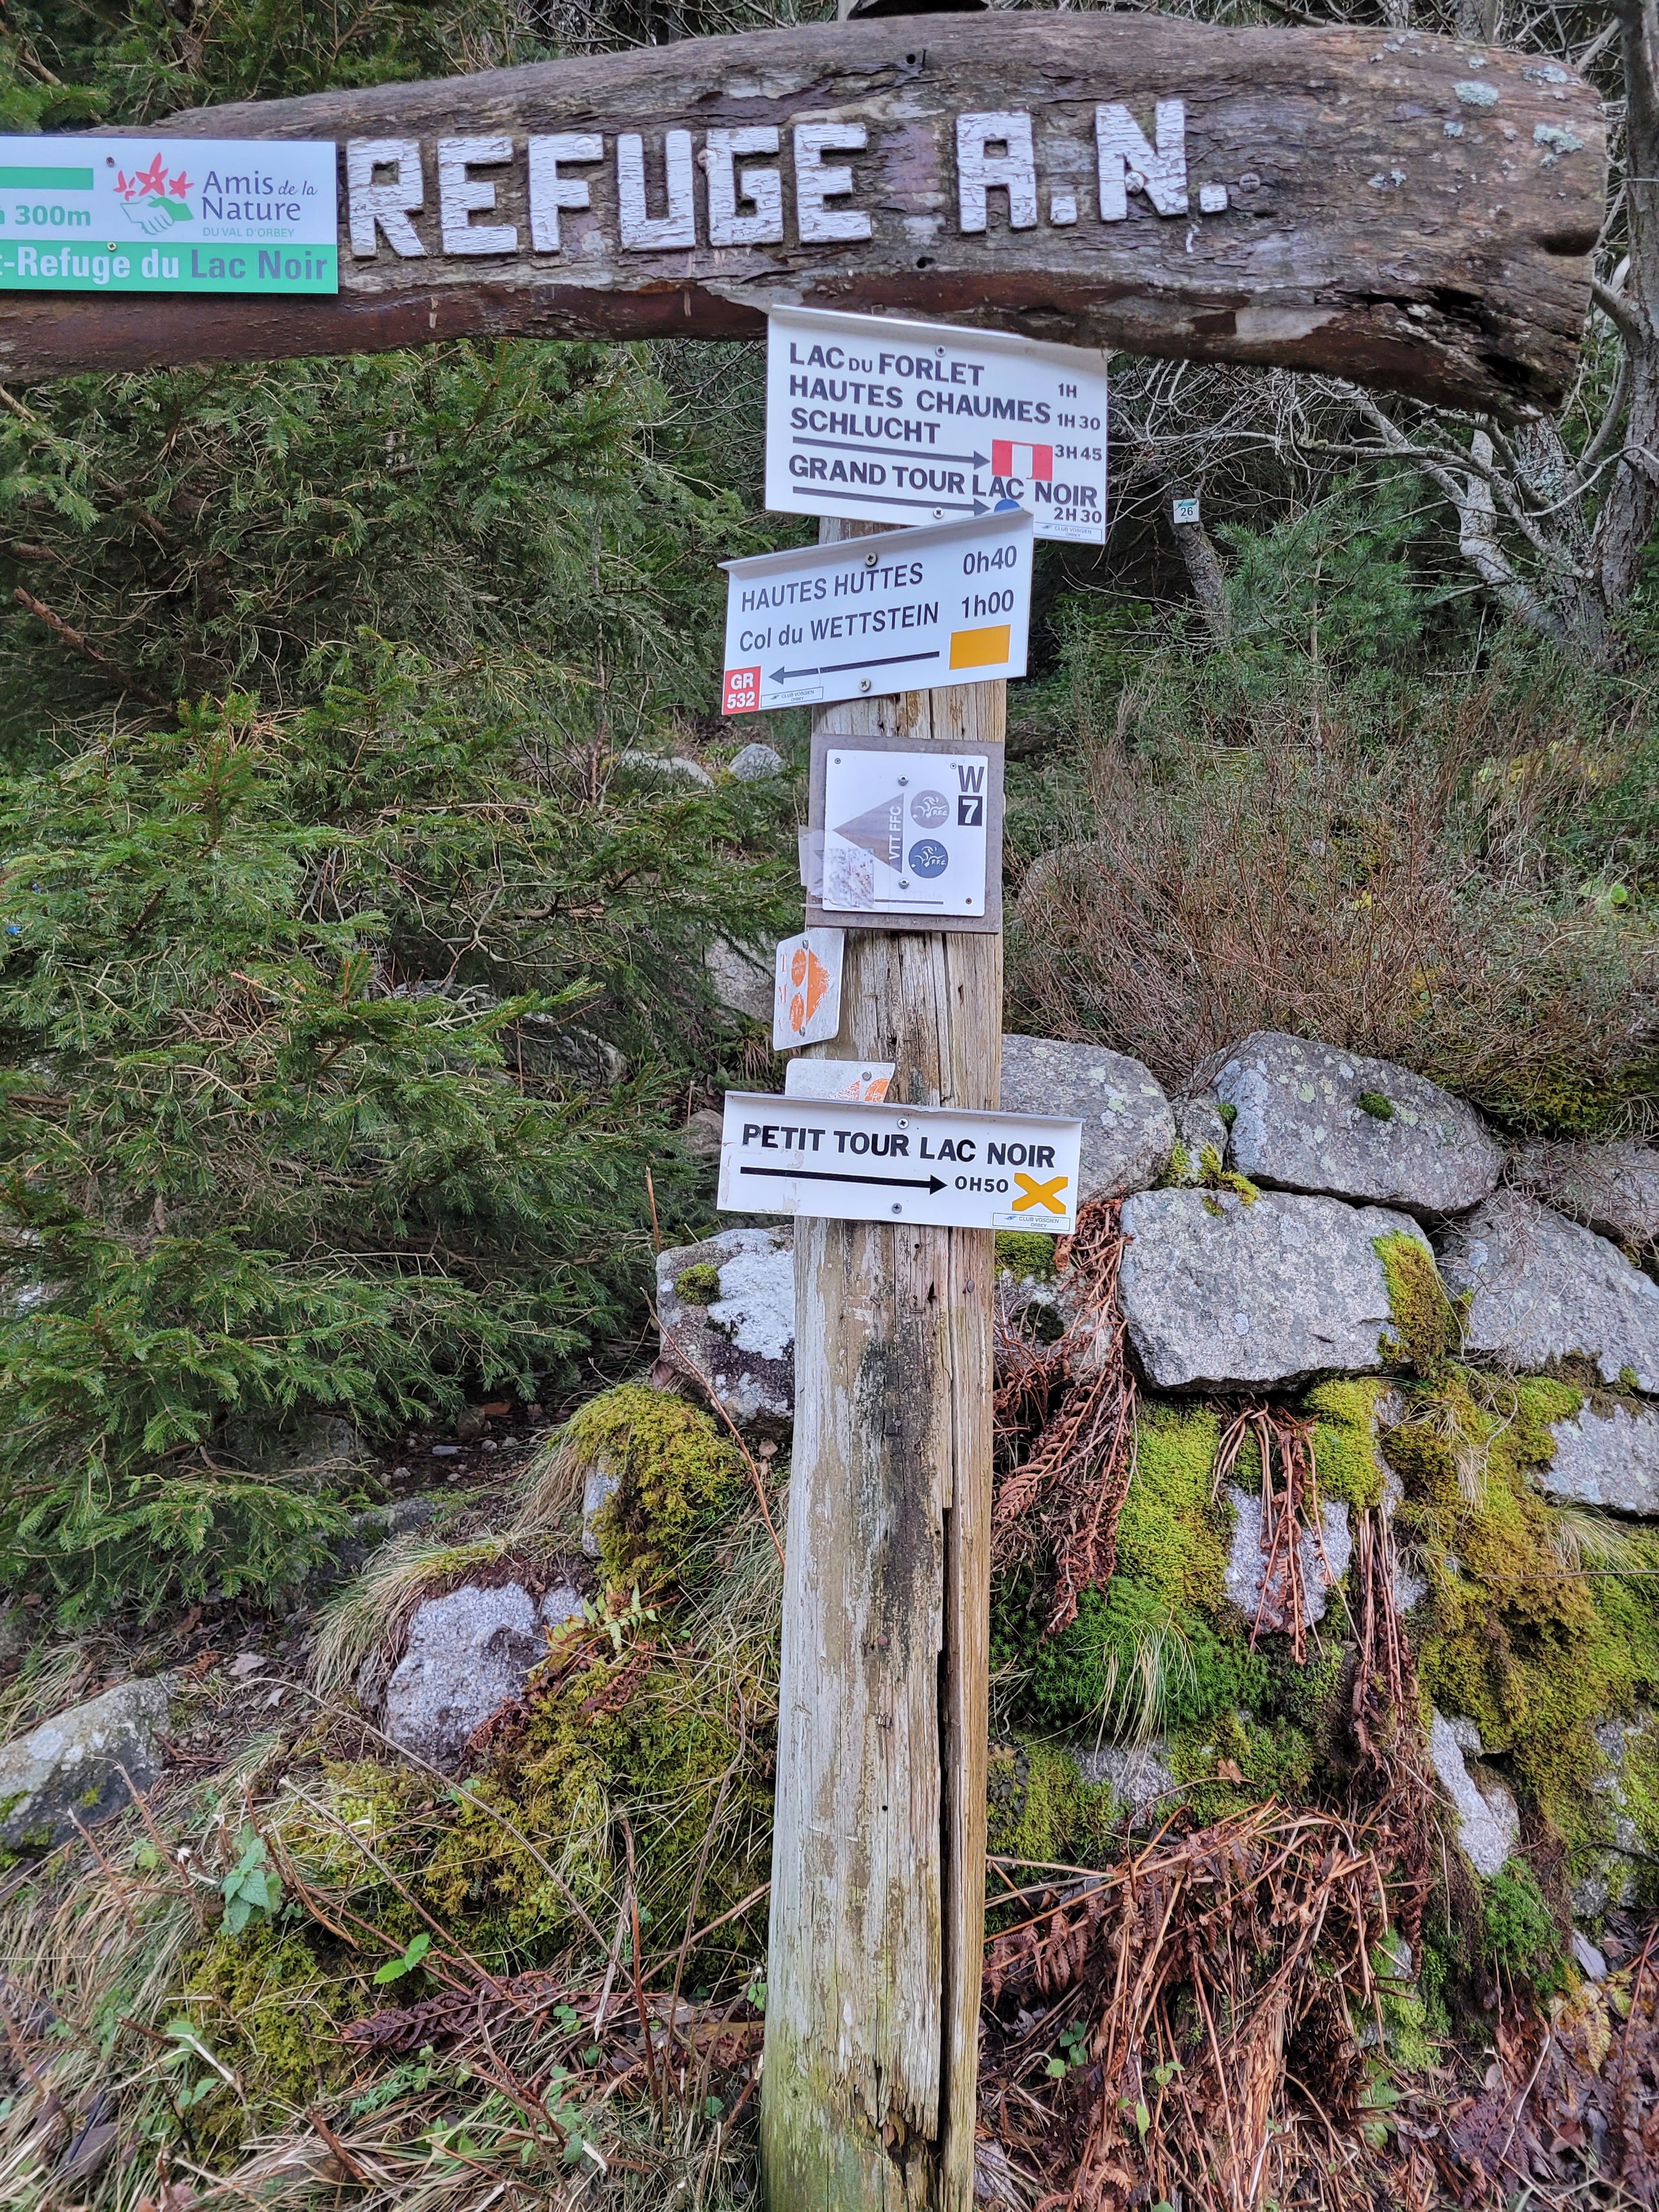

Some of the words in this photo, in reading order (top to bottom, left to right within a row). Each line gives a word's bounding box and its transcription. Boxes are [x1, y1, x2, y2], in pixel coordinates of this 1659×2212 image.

[202, 171, 274, 194] Amis
[278, 180, 298, 194] de
[302, 180, 318, 195] la
[346, 122, 872, 258] REFUGE
[956, 99, 1228, 233] A.N.
[15, 205, 91, 226] 300m
[201, 196, 301, 221] Nature
[203, 227, 219, 236] DU
[221, 227, 242, 237] VAL
[247, 228, 295, 238] D'ORBEY
[0, 246, 130, 285] -Refuge
[142, 249, 179, 278] du
[191, 250, 245, 279] Lac
[259, 250, 328, 280] Noir
[790, 342, 845, 369] LAC
[849, 358, 873, 373] DU
[879, 352, 984, 386] FORLET
[790, 374, 903, 409] HAUTES
[917, 390, 1051, 424] CHAUMES
[1058, 383, 1077, 398] 1H
[790, 407, 940, 444] SCHLUCHT
[789, 454, 887, 486] GRAND
[892, 465, 965, 494] TOUR
[973, 475, 1024, 500] LAC
[1035, 481, 1097, 509] NOIR
[1181, 507, 1193, 516] 26
[963, 545, 1017, 575] 0h40
[741, 578, 827, 612] HAUTES
[834, 562, 923, 596] HUTTES
[962, 589, 1014, 618] 1h00
[740, 628, 770, 651] Col
[778, 624, 803, 646] du
[811, 602, 939, 641] WETTSTEIN
[731, 673, 753, 690] GR
[727, 691, 755, 709] 532
[958, 765, 984, 793] W
[889, 805, 901, 833] FFC
[962, 799, 979, 823] 7
[889, 834, 900, 860] VTT
[743, 1124, 825, 1150] PETIT
[834, 1131, 909, 1157] TOUR
[920, 1137, 976, 1162] LAC
[988, 1143, 1055, 1168] NOIR
